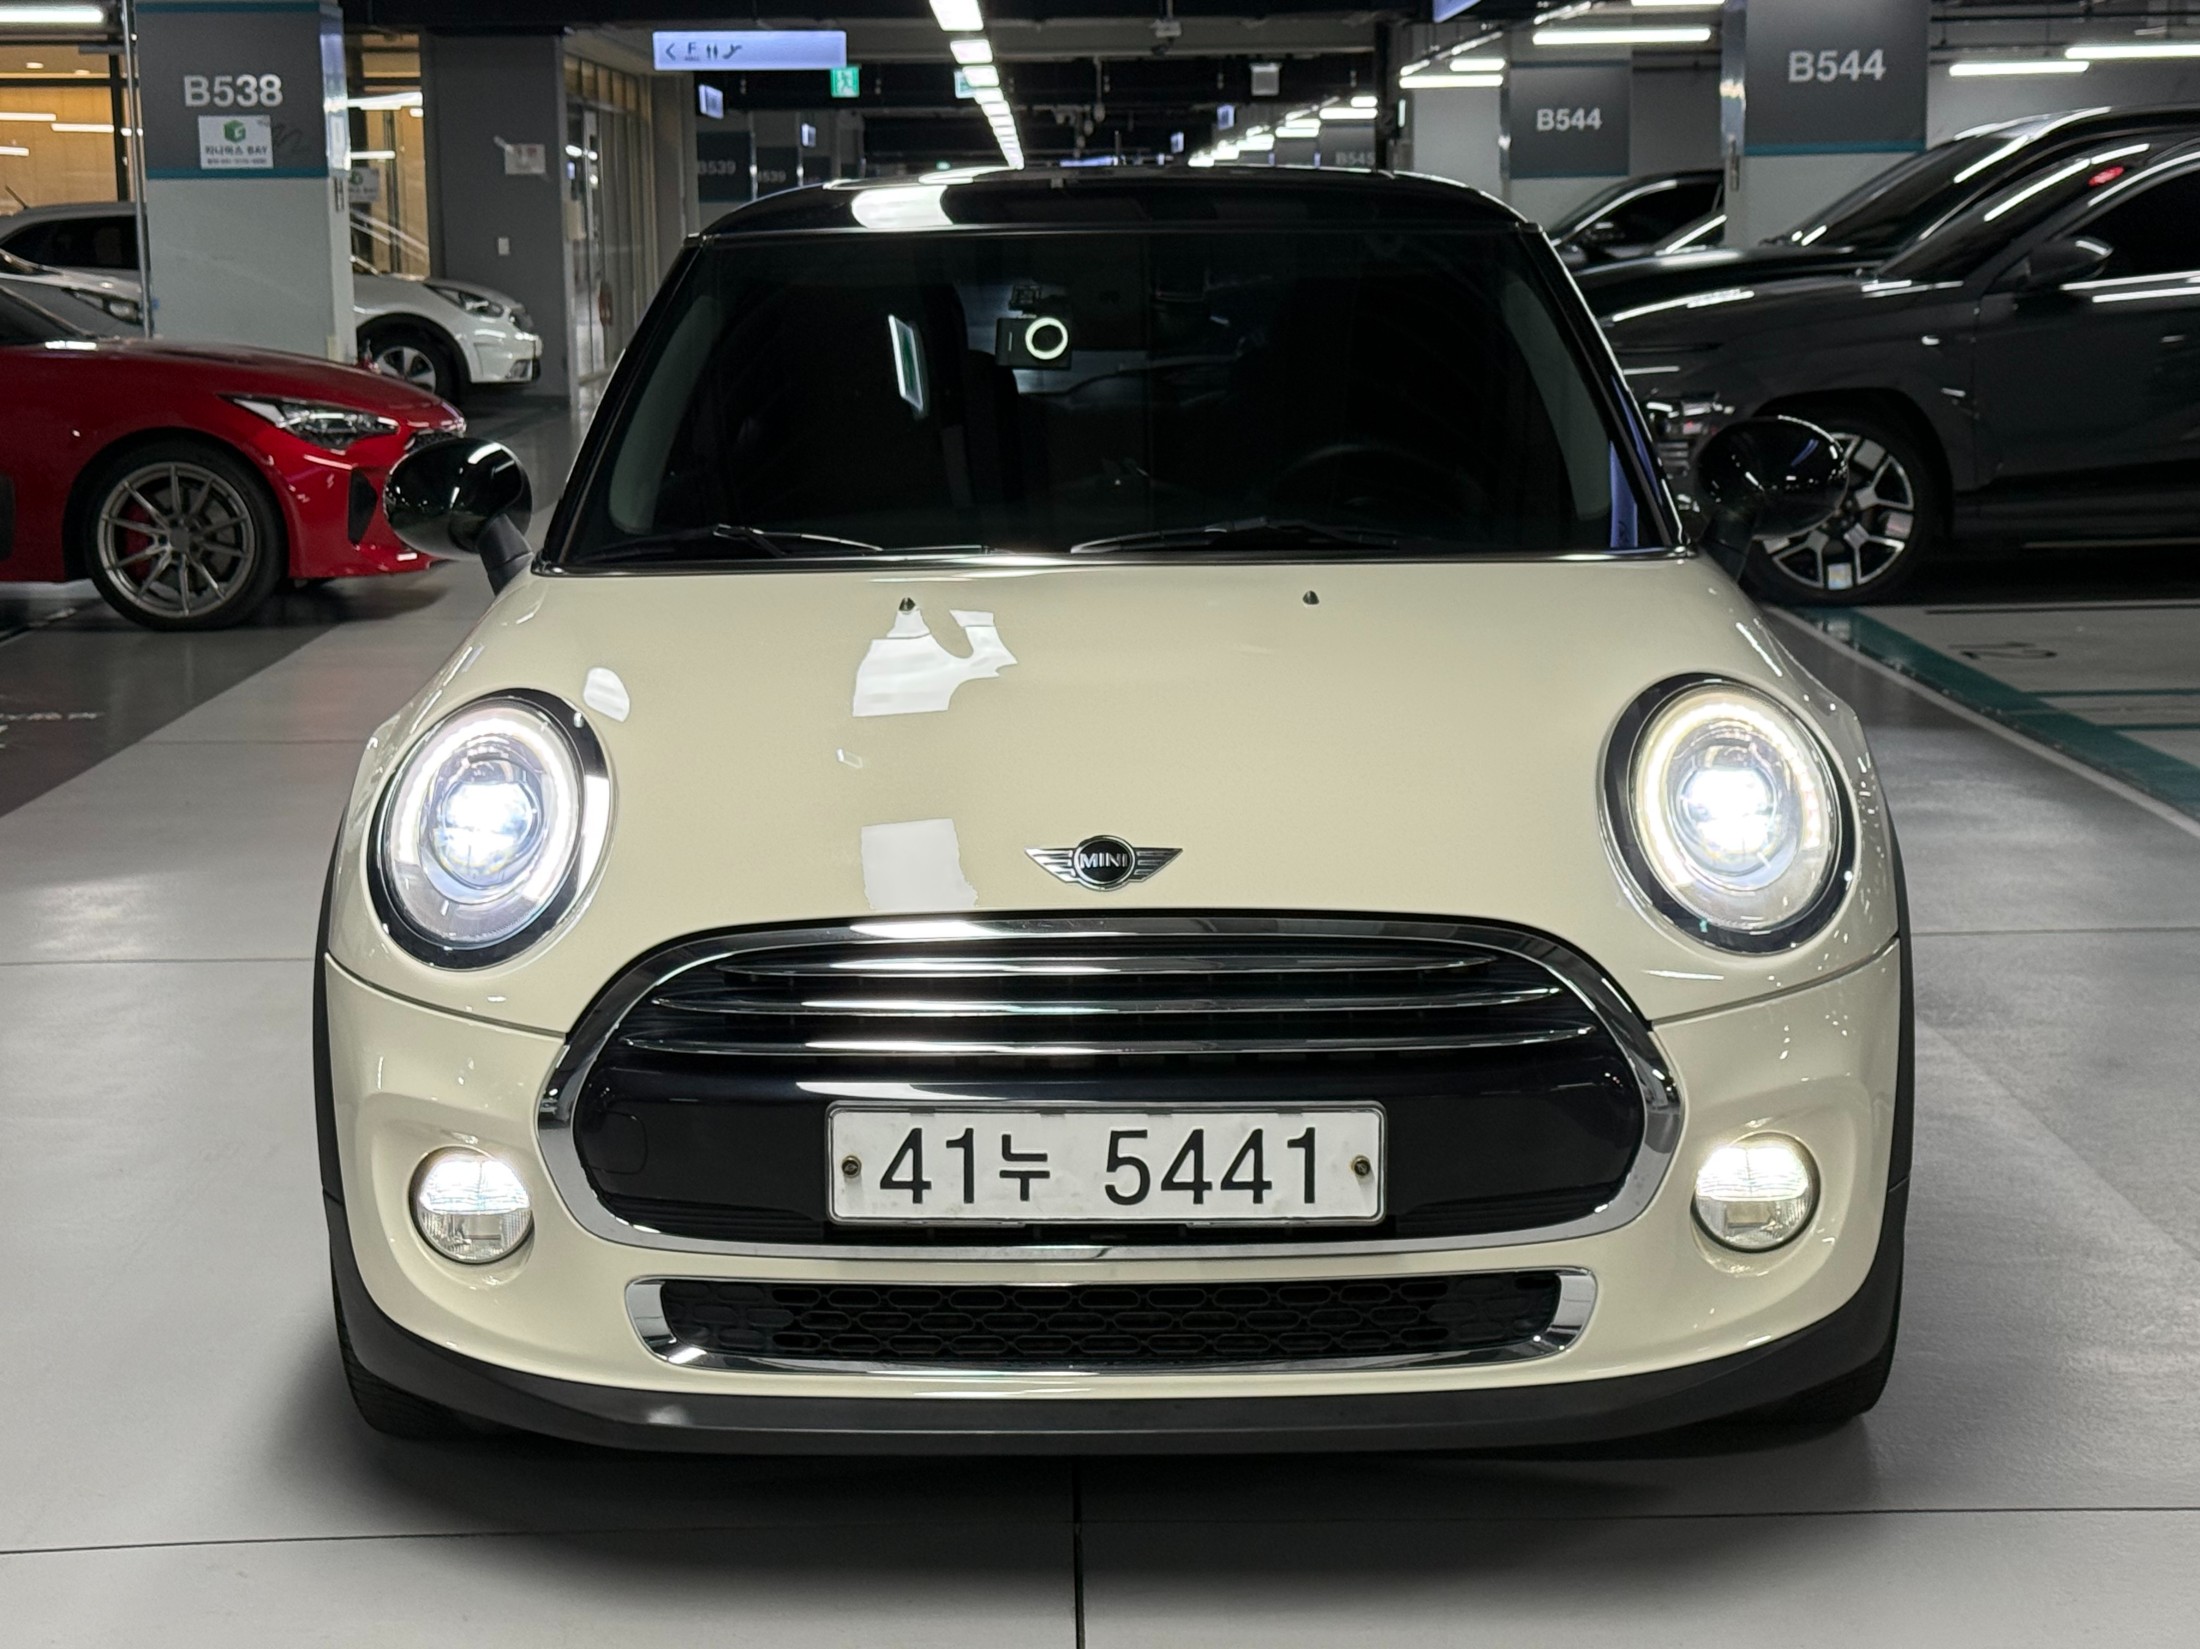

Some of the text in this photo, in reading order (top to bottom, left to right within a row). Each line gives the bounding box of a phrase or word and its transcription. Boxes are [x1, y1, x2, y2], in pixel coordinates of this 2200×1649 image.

[1788, 48, 1886, 83] B544
[183, 73, 284, 108] B538
[1536, 107, 1603, 132] B544
[1079, 852, 1129, 869] MINI
[880, 1127, 1316, 1206] 41누 5441
